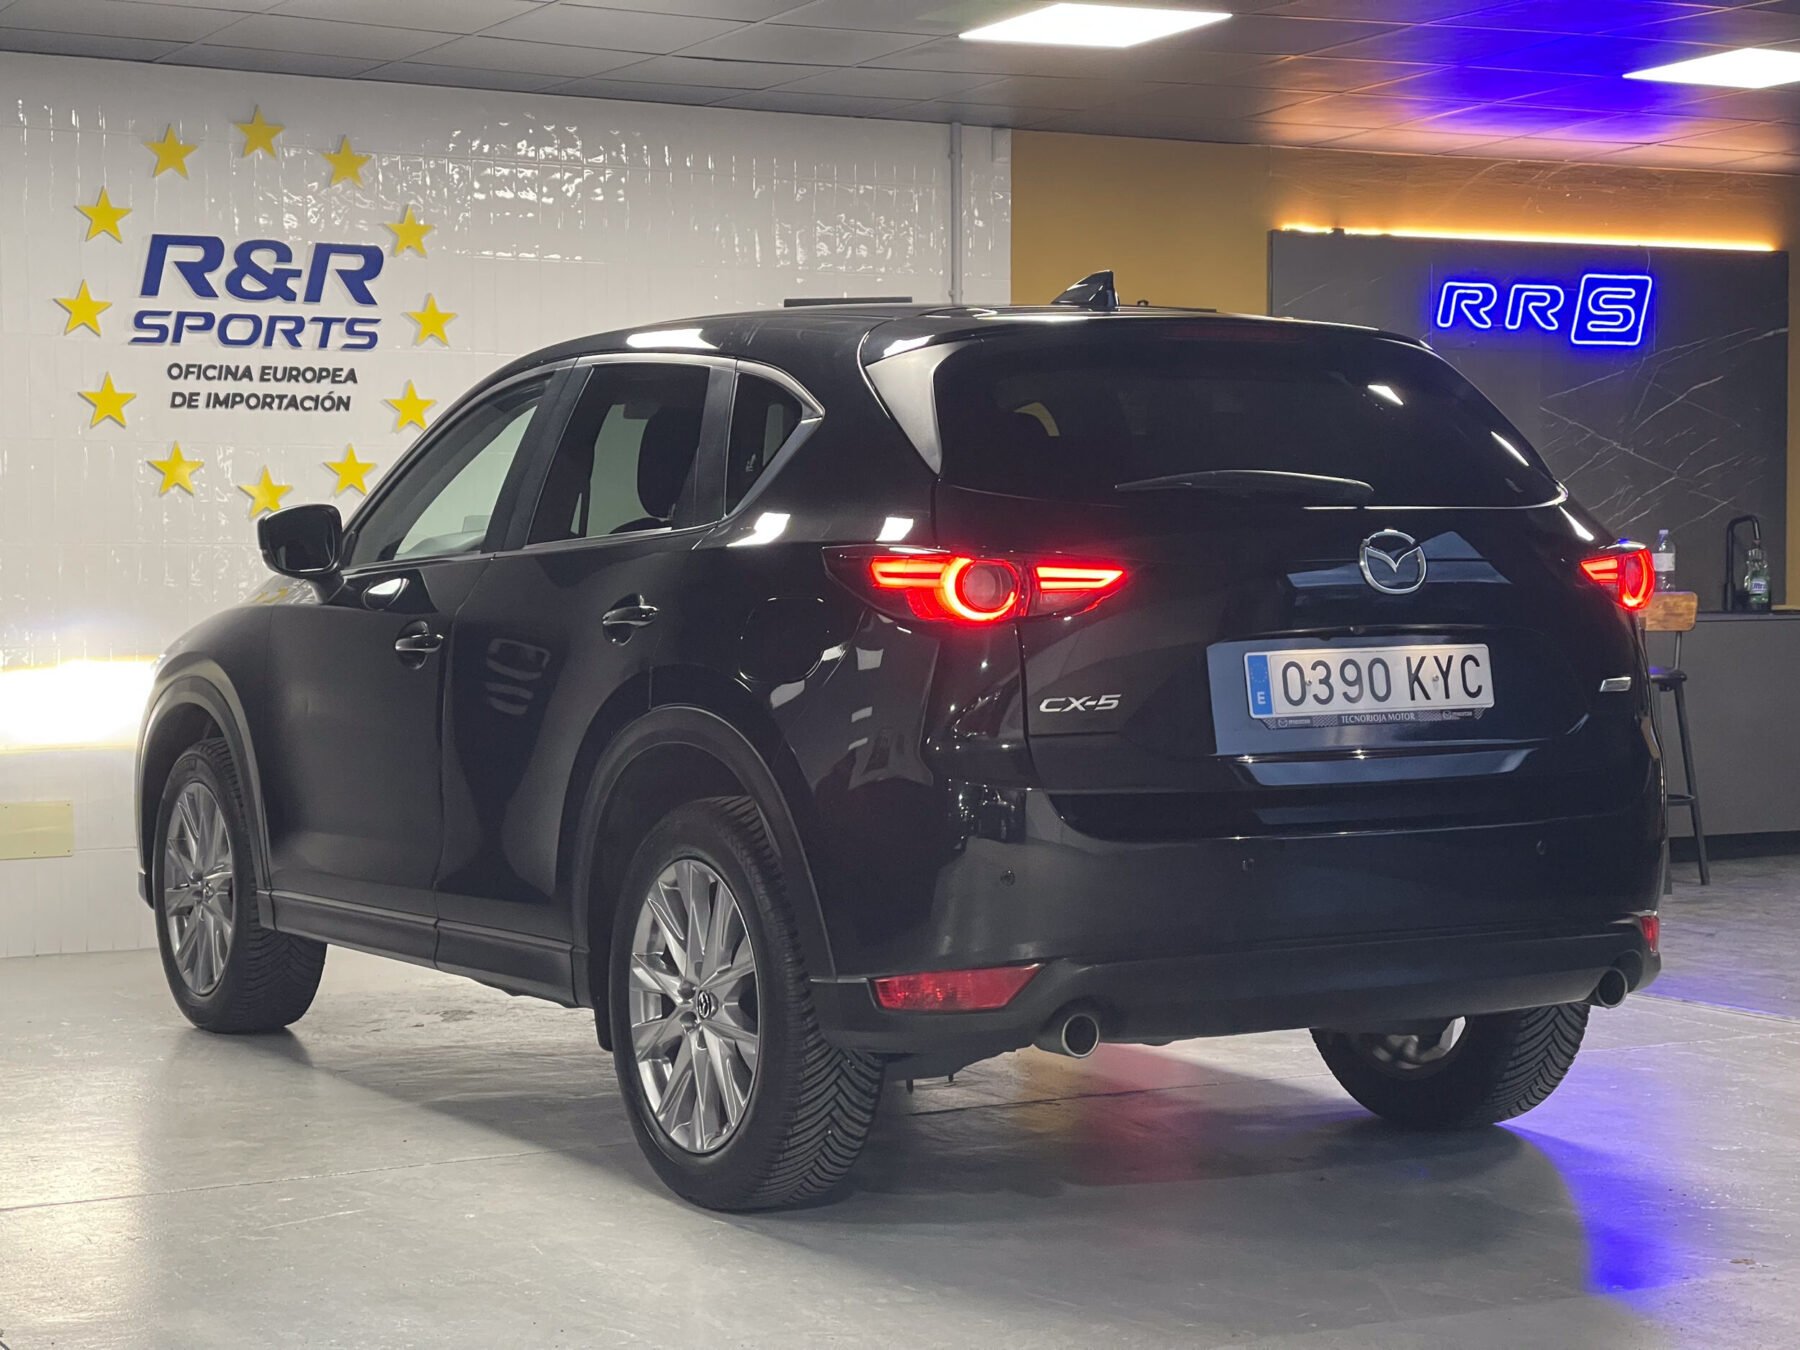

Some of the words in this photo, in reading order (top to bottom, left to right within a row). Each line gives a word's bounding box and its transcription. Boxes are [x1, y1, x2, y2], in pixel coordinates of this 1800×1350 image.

[140, 234, 385, 306] R&R
[128, 310, 382, 351] SPORTS
[167, 363, 253, 382] OFICINA
[259, 366, 358, 384] EUROPEA
[170, 392, 200, 409] DE
[205, 391, 351, 412] IMPORTACIÓN
[1281, 657, 1393, 706] 0390
[1405, 654, 1483, 702] KYC
[1039, 694, 1121, 712] CX-5
[1257, 691, 1266, 705] E
[1341, 714, 1387, 724] TECNORIOJA
[1388, 712, 1416, 722] MOTOR
